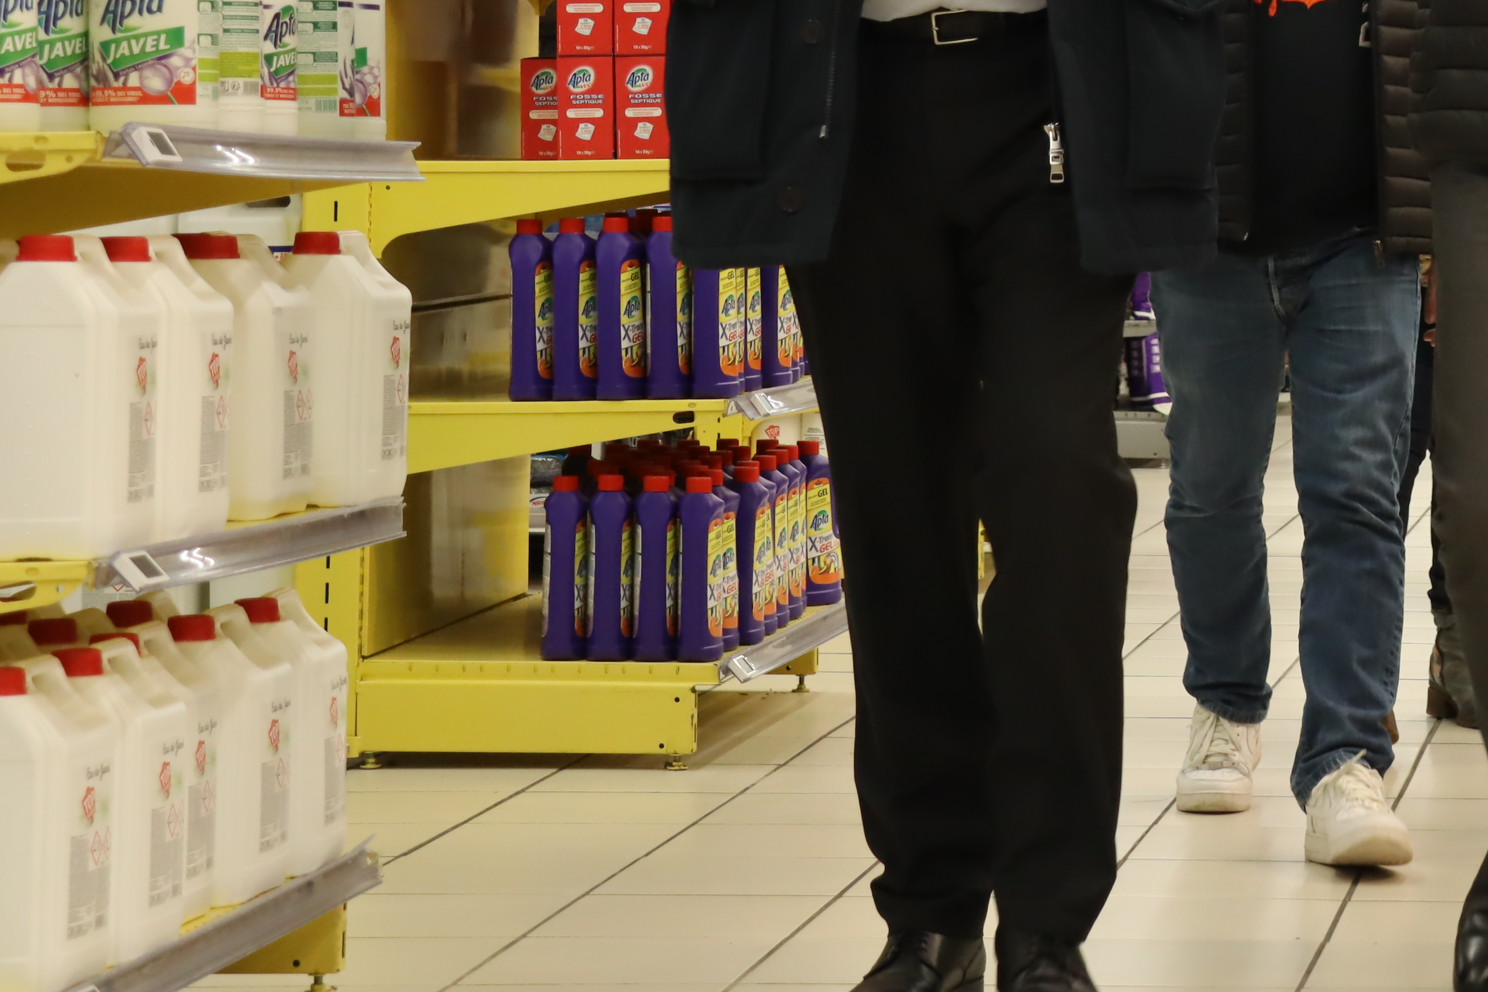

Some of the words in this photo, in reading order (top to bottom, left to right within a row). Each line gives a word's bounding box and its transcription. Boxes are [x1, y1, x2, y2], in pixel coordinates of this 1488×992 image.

[1, 32, 37, 54] AVEL
[107, 34, 171, 64] JAVEL
[531, 74, 554, 91] Apta
[567, 72, 591, 89] Apta
[626, 71, 649, 88] Apta
[766, 427, 780, 439] TOP
